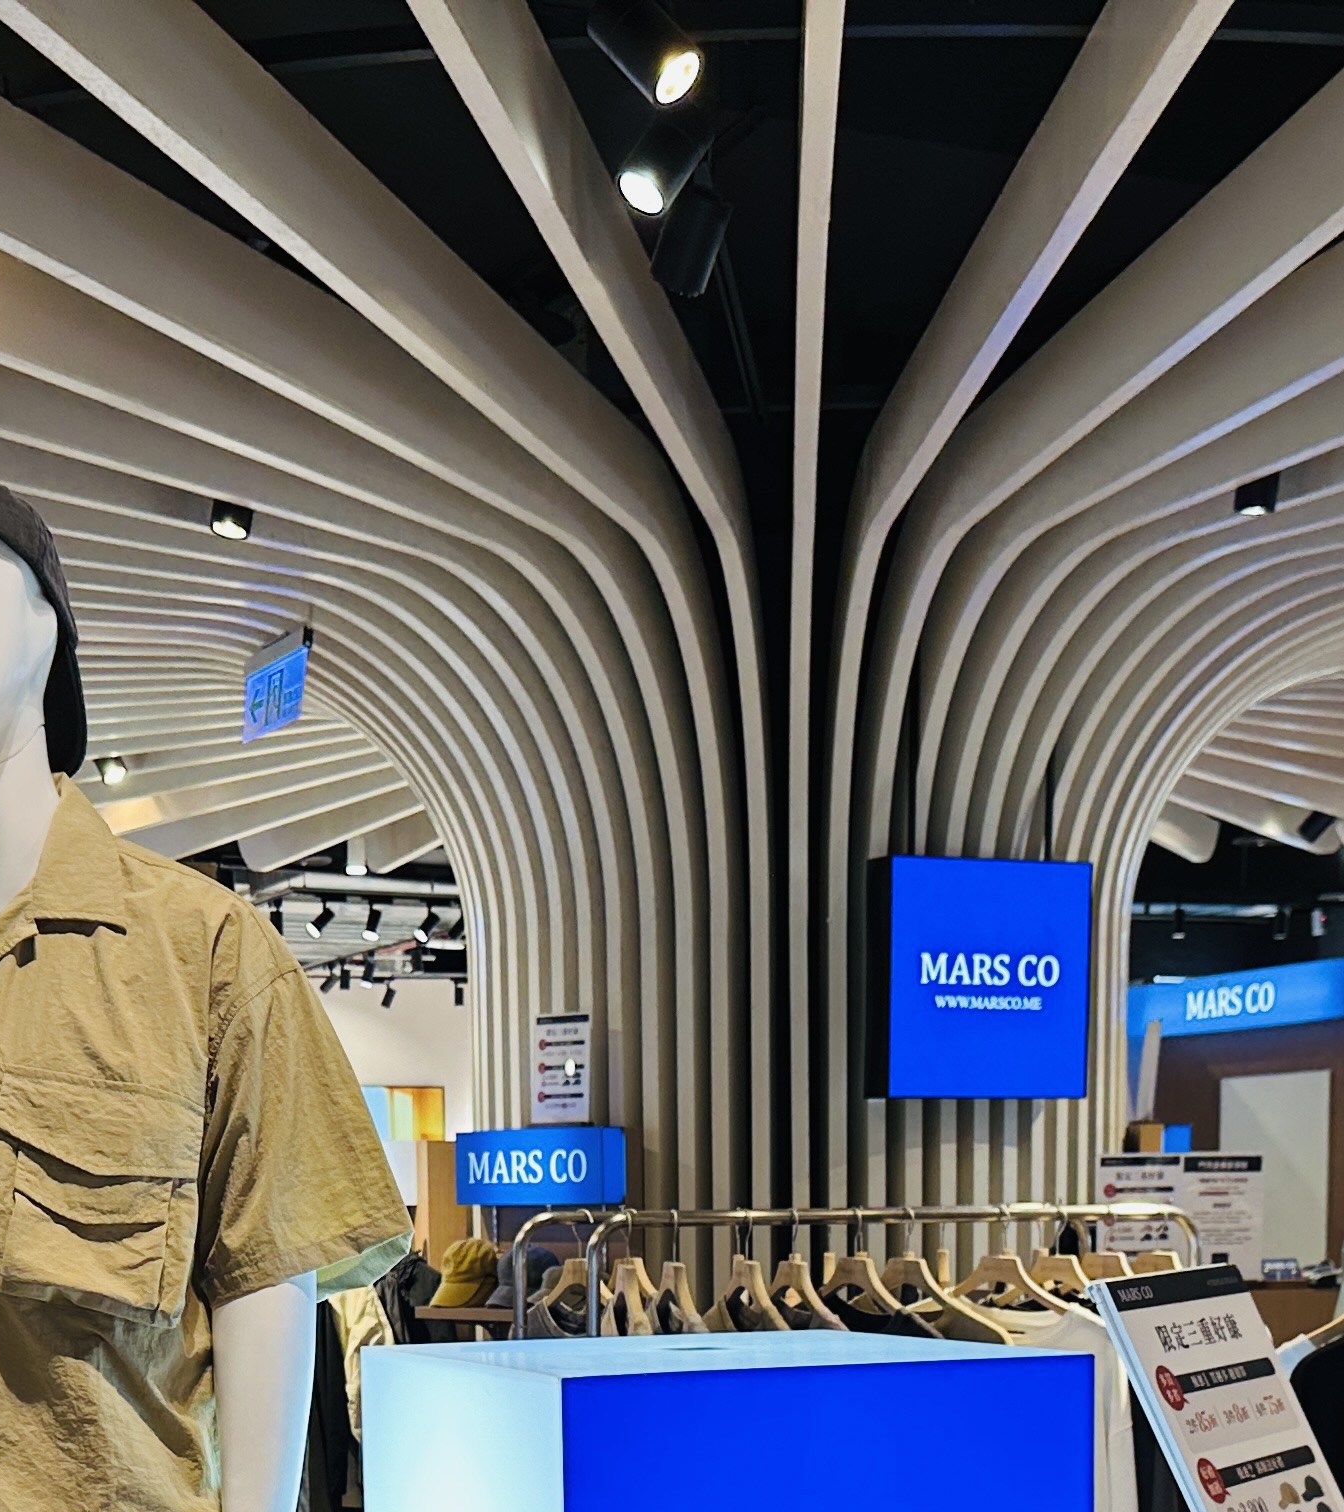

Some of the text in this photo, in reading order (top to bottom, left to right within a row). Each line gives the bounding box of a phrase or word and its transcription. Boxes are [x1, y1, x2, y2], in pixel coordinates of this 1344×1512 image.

[920, 952, 1060, 987] MARS CO
[934, 995, 1042, 1010] WWW.MARSCO.ME
[1186, 981, 1275, 1020] MARS CO
[468, 1148, 587, 1184] MARS CO
[1117, 1286, 1154, 1303] MARS CO
[1154, 1313, 1243, 1352] 限定三重好康
